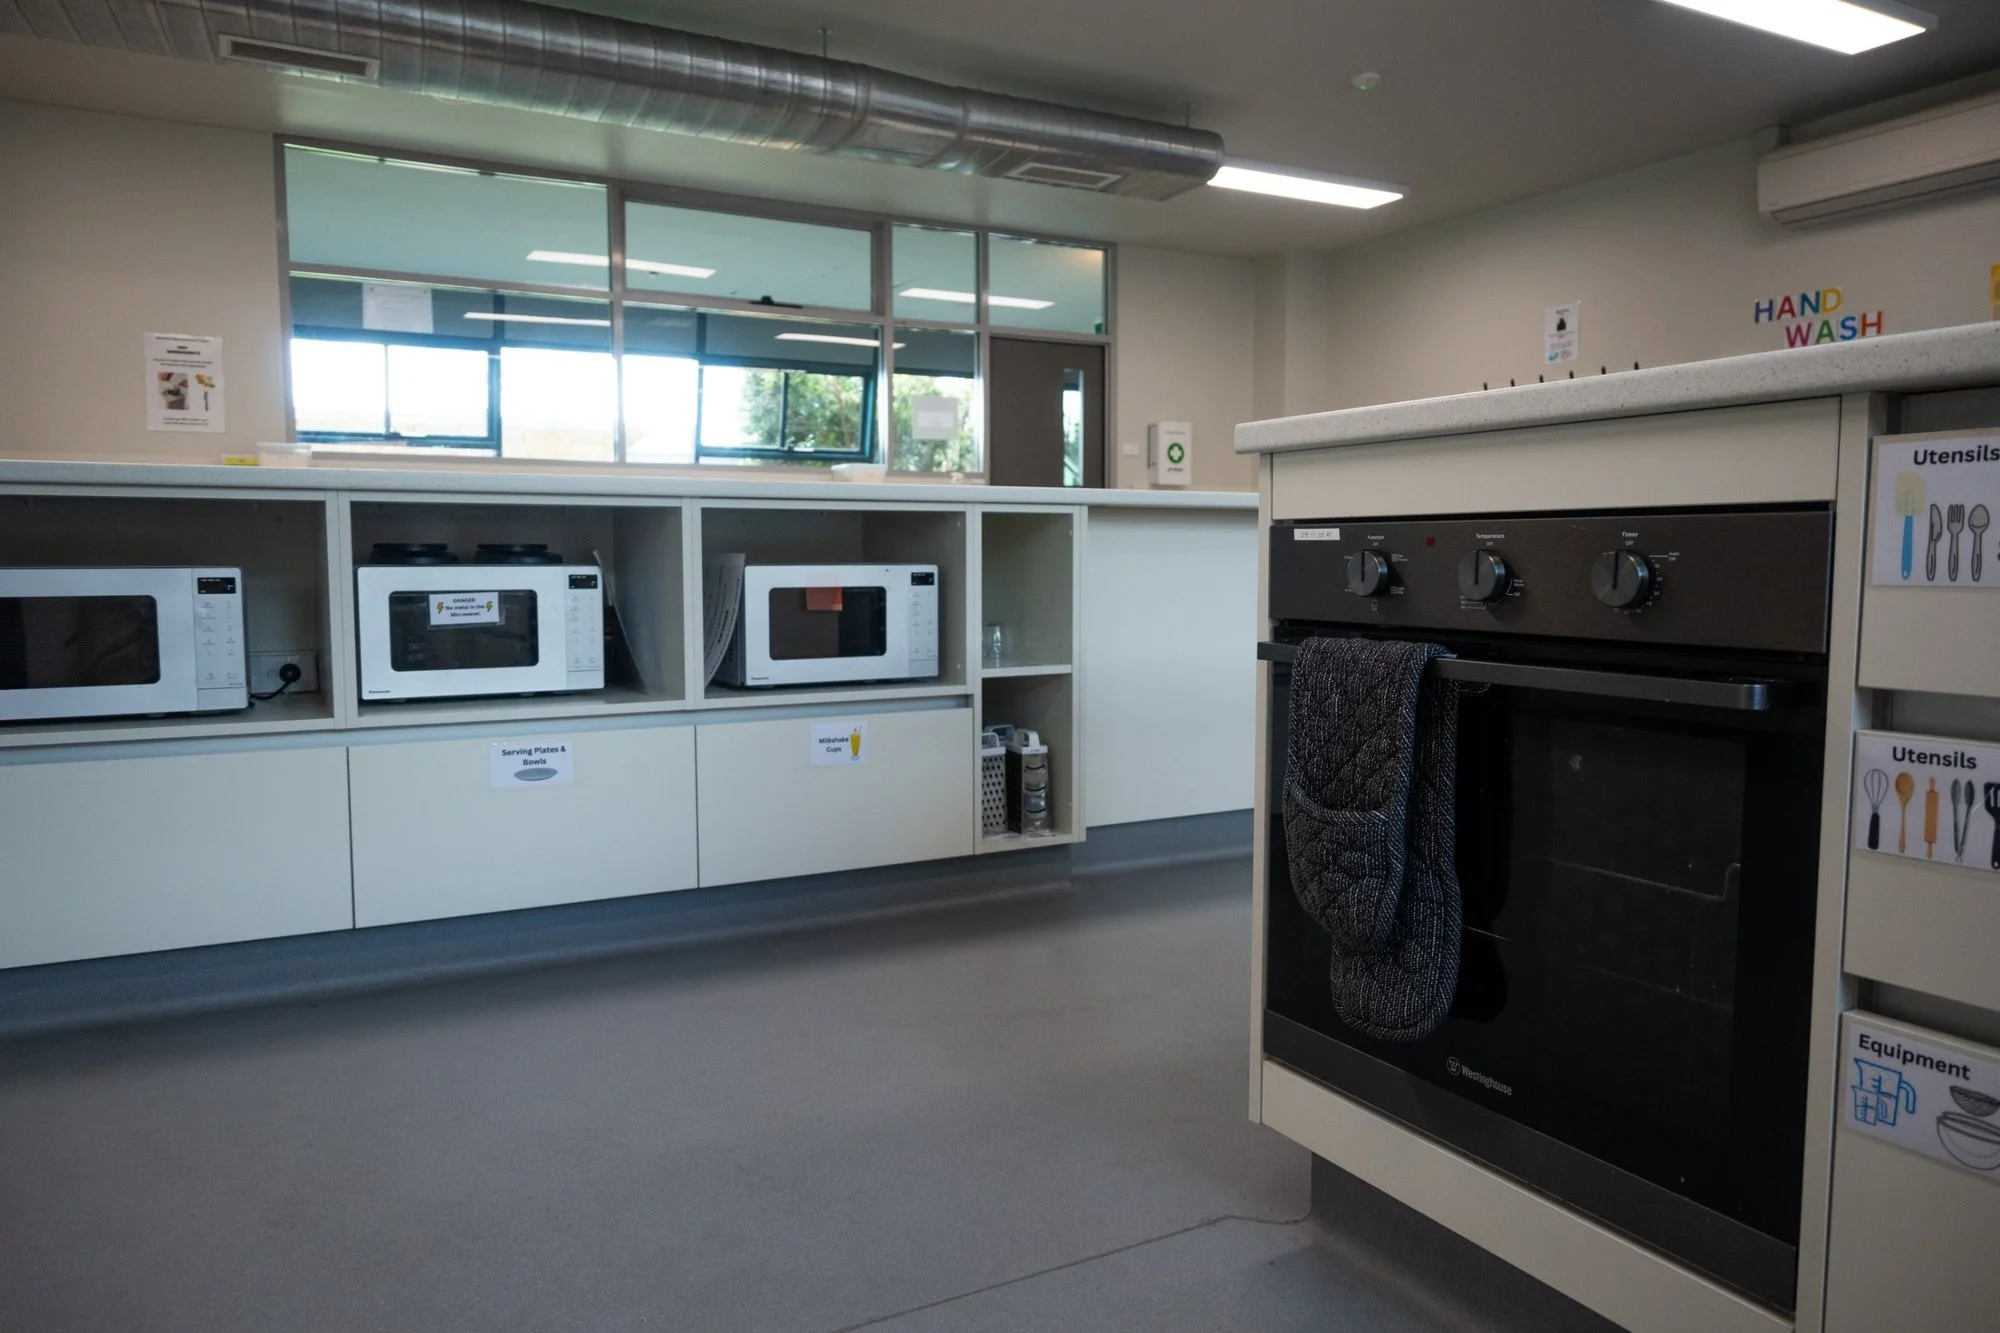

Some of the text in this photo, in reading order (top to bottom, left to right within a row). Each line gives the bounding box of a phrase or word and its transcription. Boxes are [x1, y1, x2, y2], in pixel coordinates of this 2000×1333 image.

[1754, 287, 1843, 324] HAND
[1785, 311, 1883, 348] WASH
[1913, 444, 2000, 466] Utensils
[502, 745, 566, 757] Serving Plates &
[818, 736, 849, 744] Milkshake
[826, 746, 842, 754] Cups
[522, 758, 547, 766] Bowls
[1892, 746, 1978, 770] Utensils
[1858, 1033, 1972, 1081] Equipment
[1461, 1064, 1513, 1096] Westinghouse
